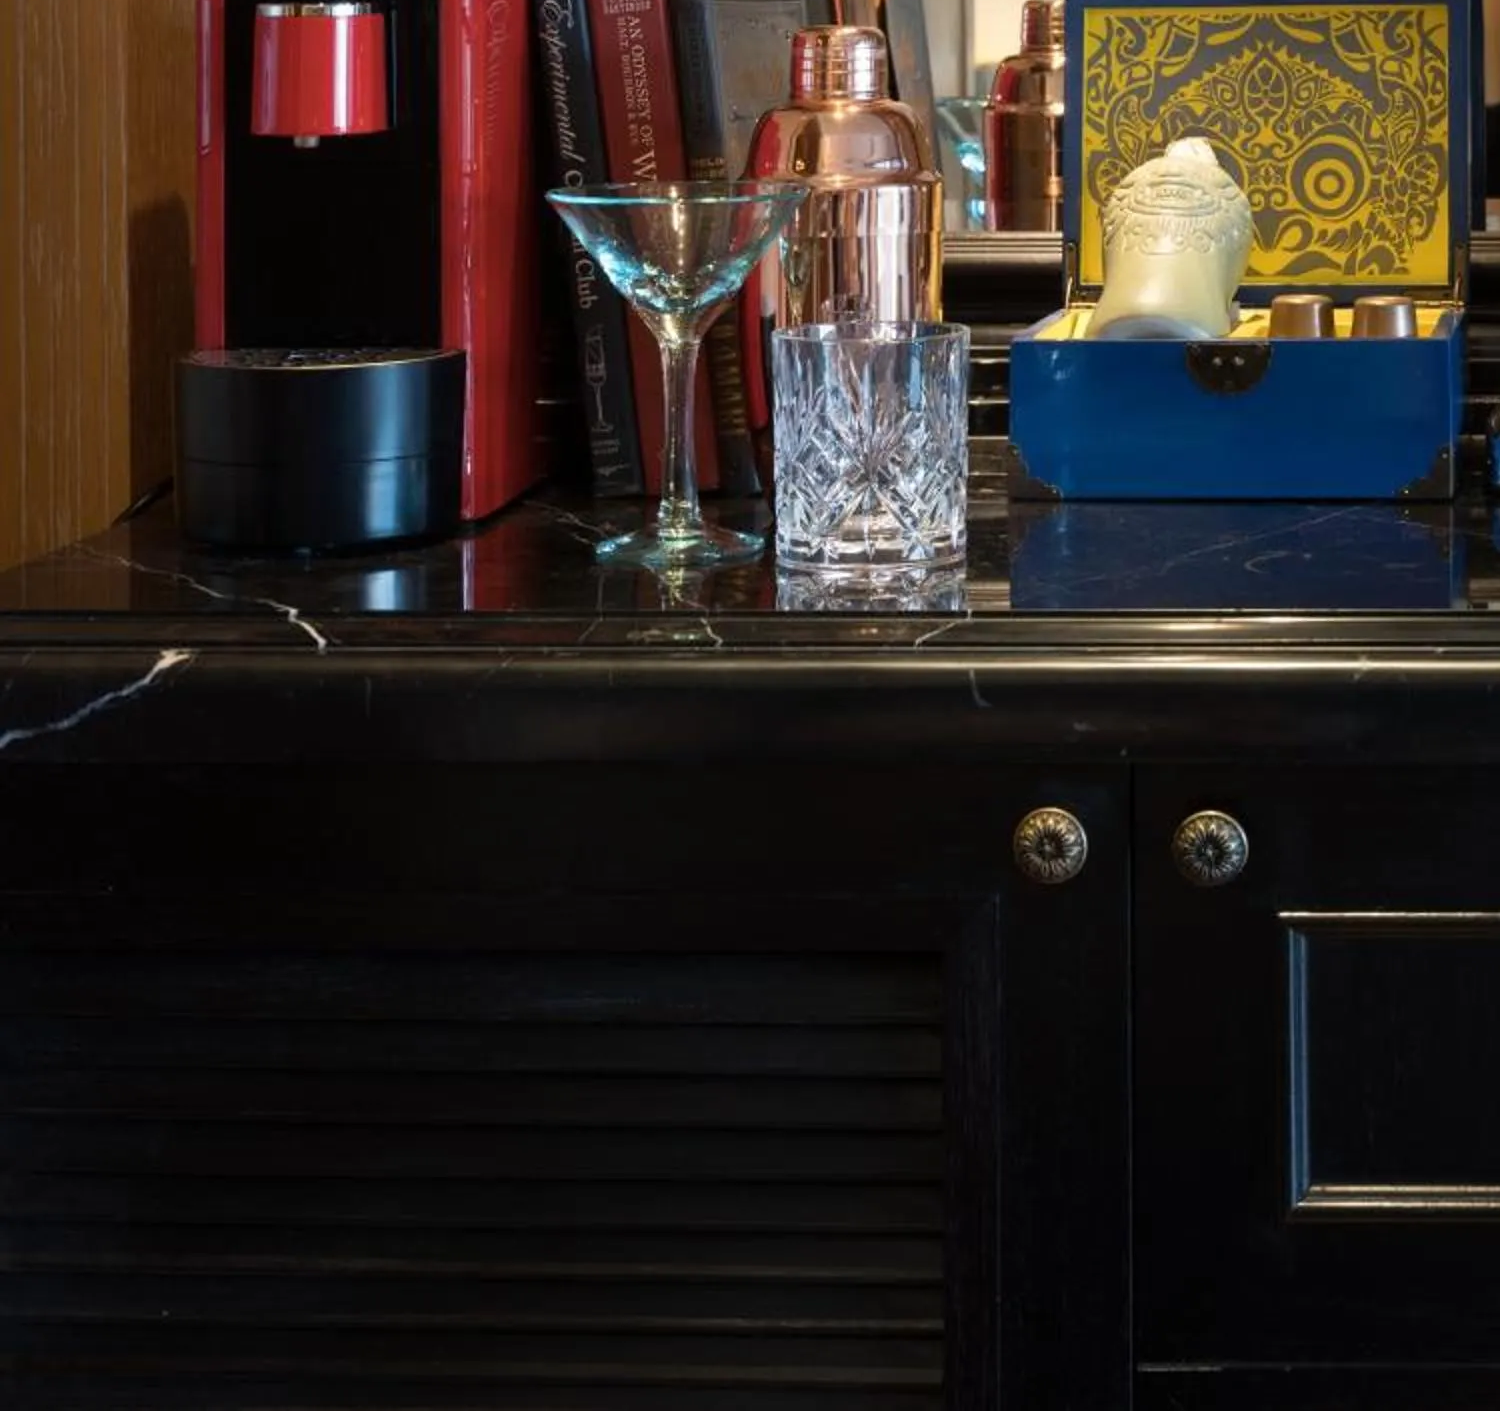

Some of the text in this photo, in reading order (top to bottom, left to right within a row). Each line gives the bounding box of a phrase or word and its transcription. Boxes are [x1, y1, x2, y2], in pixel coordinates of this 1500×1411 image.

[628, 16, 644, 39] AN
[631, 44, 652, 122] ODYSSEY
[639, 124, 655, 146] OF
[575, 260, 599, 309] Club
